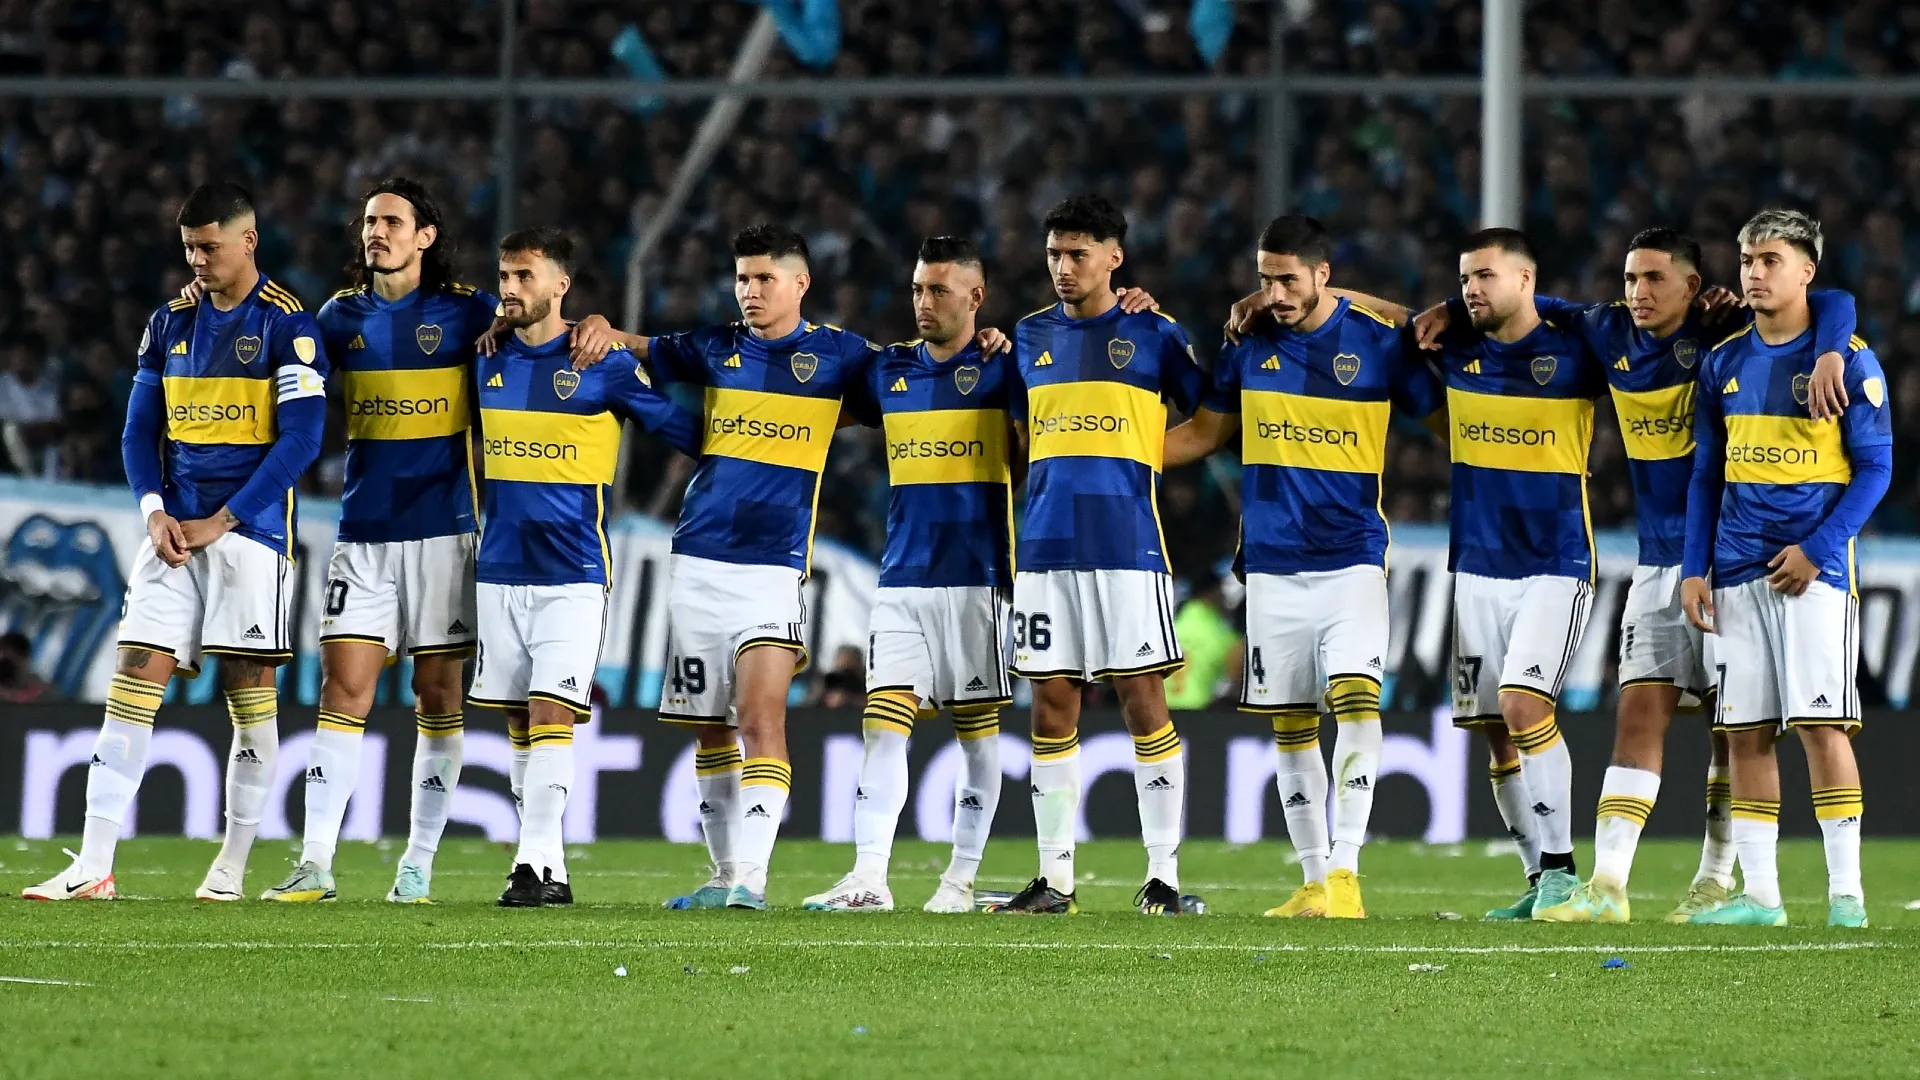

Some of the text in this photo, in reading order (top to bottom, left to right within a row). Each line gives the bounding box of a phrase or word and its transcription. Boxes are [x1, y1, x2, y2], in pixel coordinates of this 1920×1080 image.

[1033, 412, 1130, 436] betsson
[1257, 417, 1358, 446] betsson
[1458, 418, 1556, 446] betsson
[243, 632, 266, 640] adidas
[1014, 612, 1052, 651] 36
[1252, 645, 1266, 685] 4
[1458, 655, 1483, 695] 57
[1522, 671, 1545, 681] adidas
[557, 683, 579, 693] adidas
